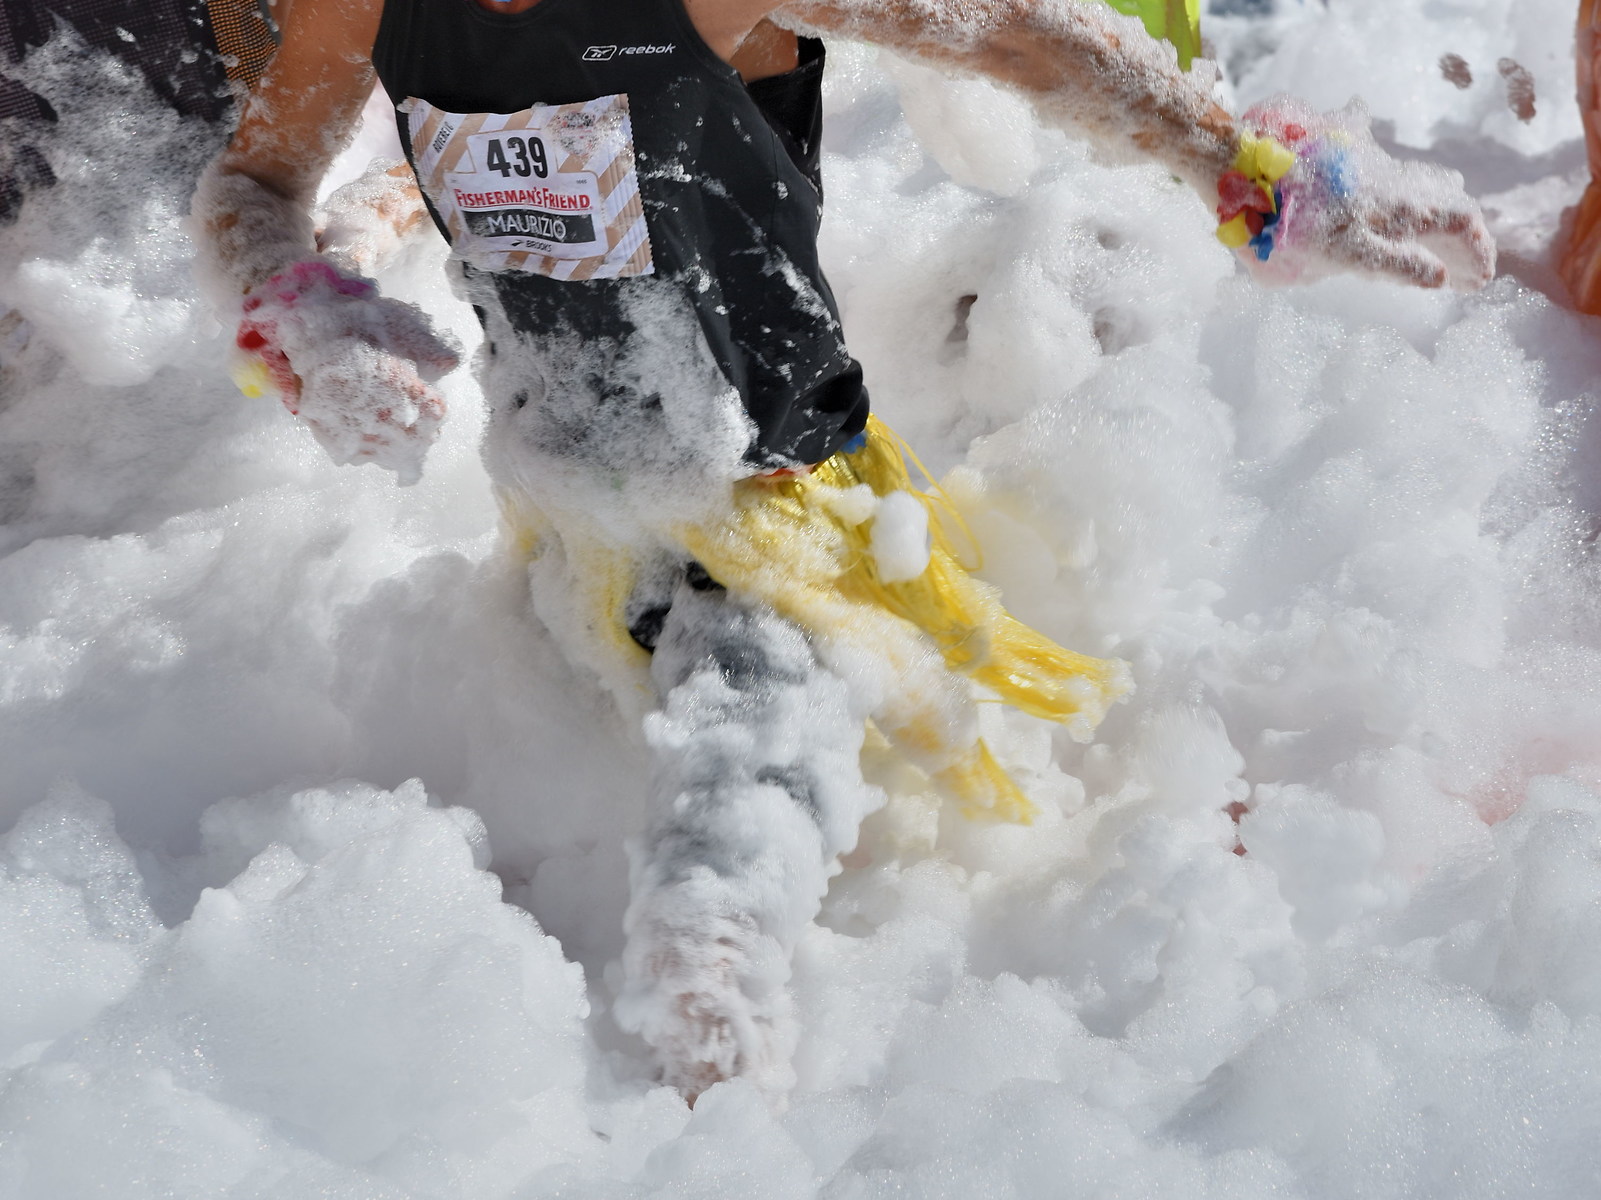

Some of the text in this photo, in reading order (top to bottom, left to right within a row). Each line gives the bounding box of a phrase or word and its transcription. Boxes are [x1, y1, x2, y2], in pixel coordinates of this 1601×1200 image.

[619, 43, 677, 56] reebok
[487, 136, 548, 179] 439
[453, 187, 591, 210] FISHERMAN'S FRIEND
[487, 213, 567, 241] MAURIZIO
[525, 240, 552, 253] BROOKS
